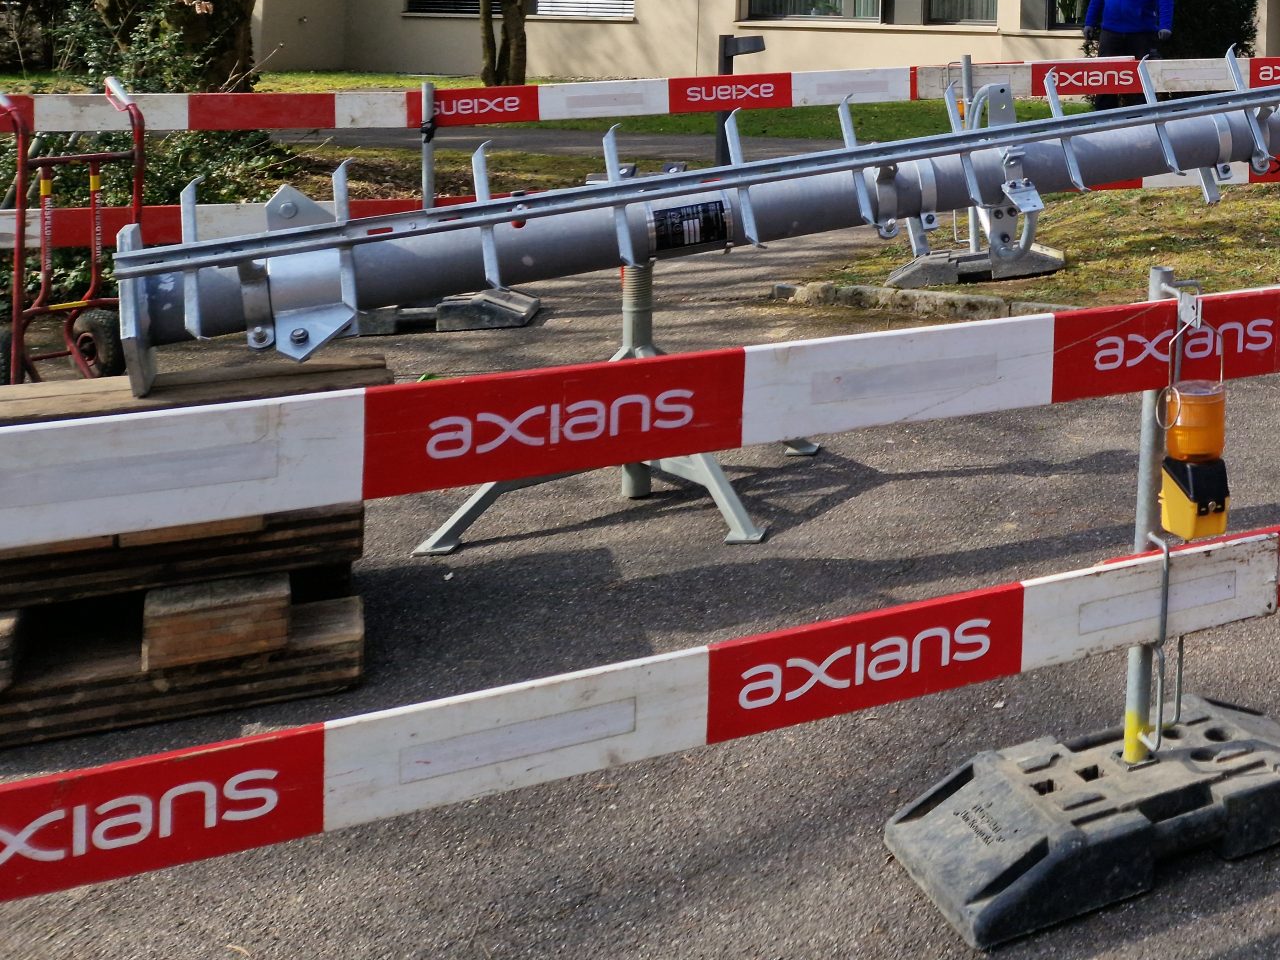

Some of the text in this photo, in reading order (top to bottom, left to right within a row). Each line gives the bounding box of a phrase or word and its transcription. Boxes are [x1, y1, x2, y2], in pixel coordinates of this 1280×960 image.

[1094, 318, 1274, 372] axans
[426, 389, 694, 459] axians
[739, 618, 991, 710] axians
[0, 769, 279, 866] xians
